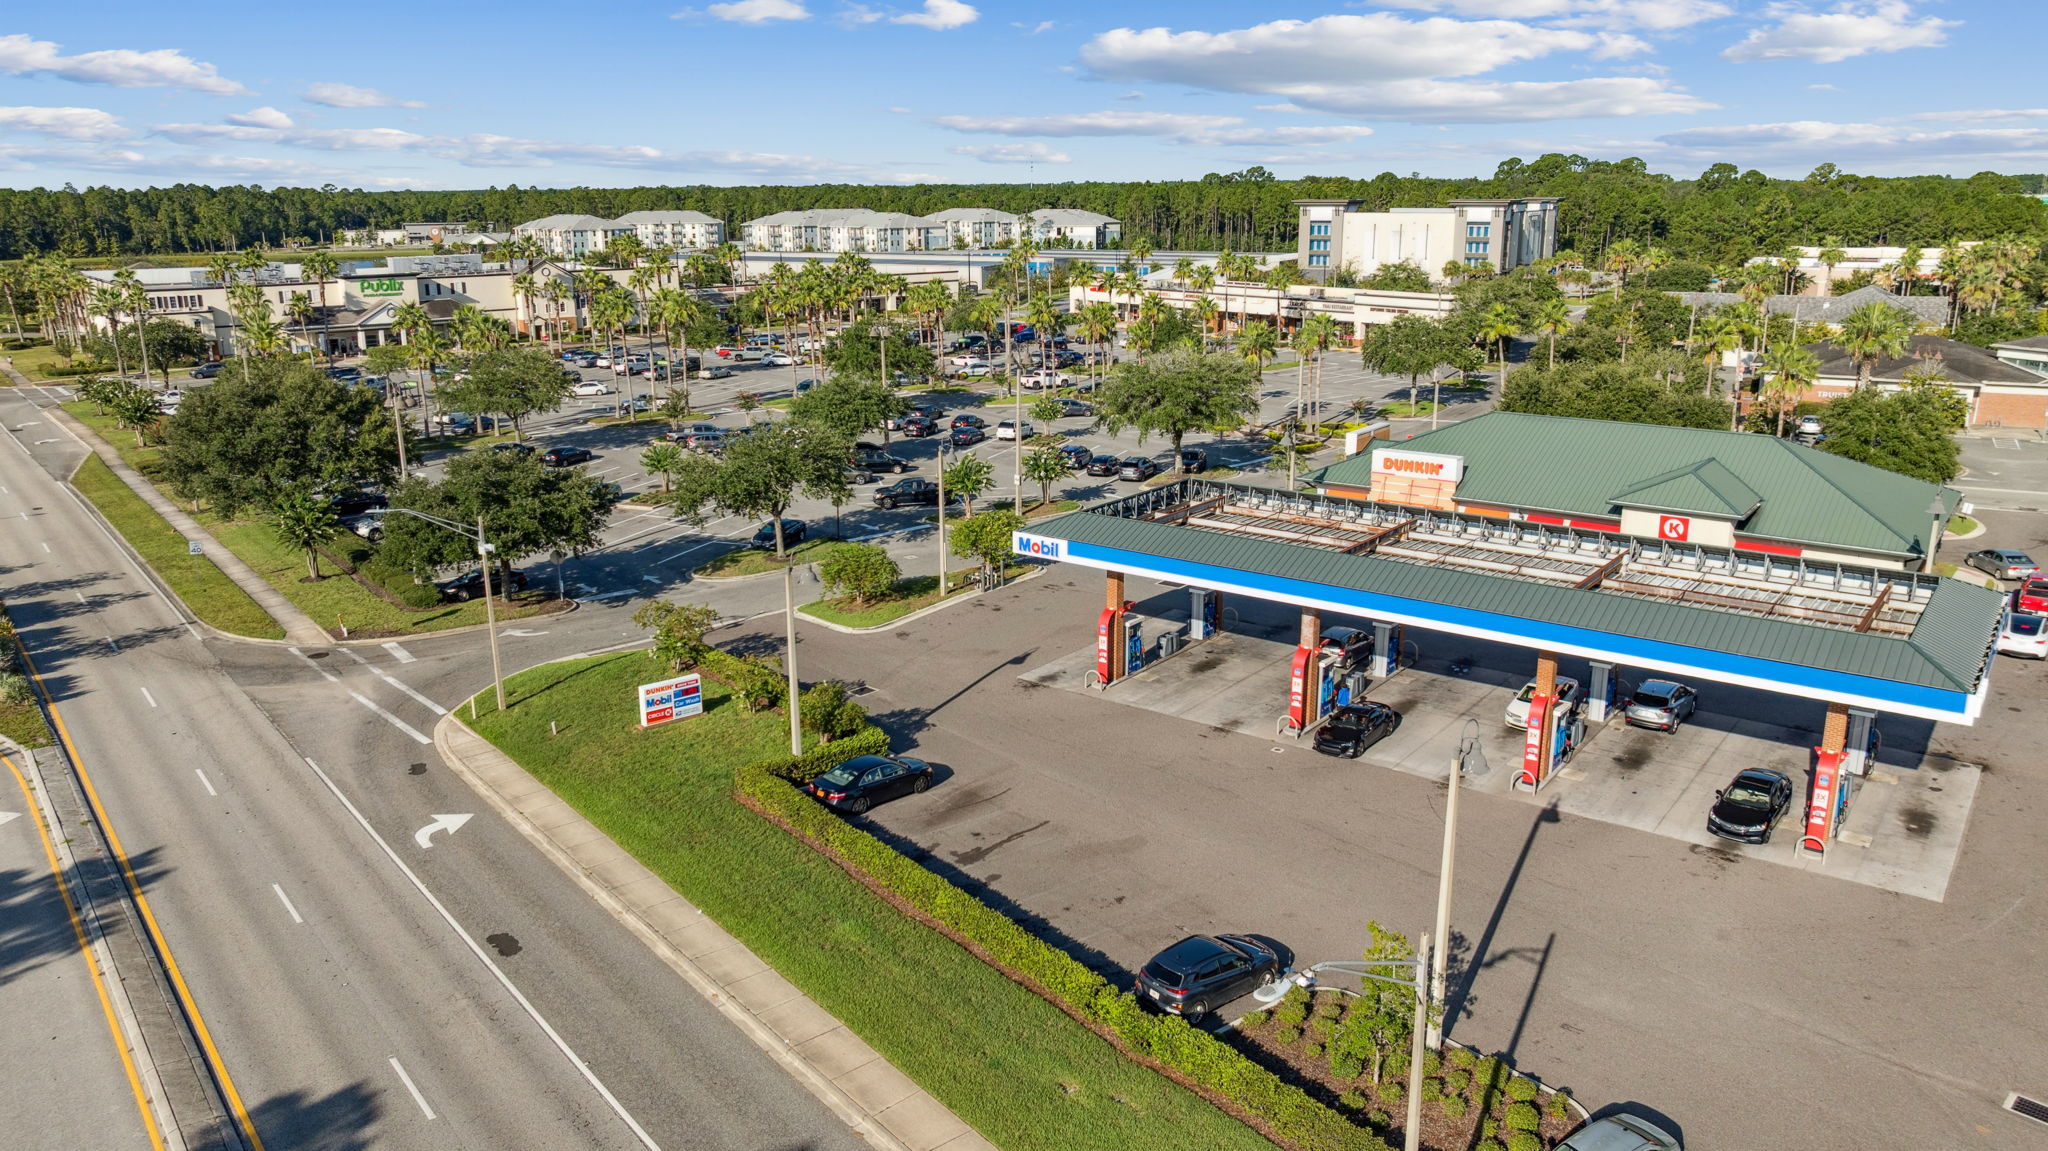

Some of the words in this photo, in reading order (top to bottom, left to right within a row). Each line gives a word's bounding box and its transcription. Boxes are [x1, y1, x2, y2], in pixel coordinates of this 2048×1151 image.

[359, 278, 405, 292] Publix
[2025, 360, 2048, 368] TRUS
[1668, 521, 1682, 537] K
[1018, 536, 1059, 558] Mobil
[647, 695, 672, 707] Mobil
